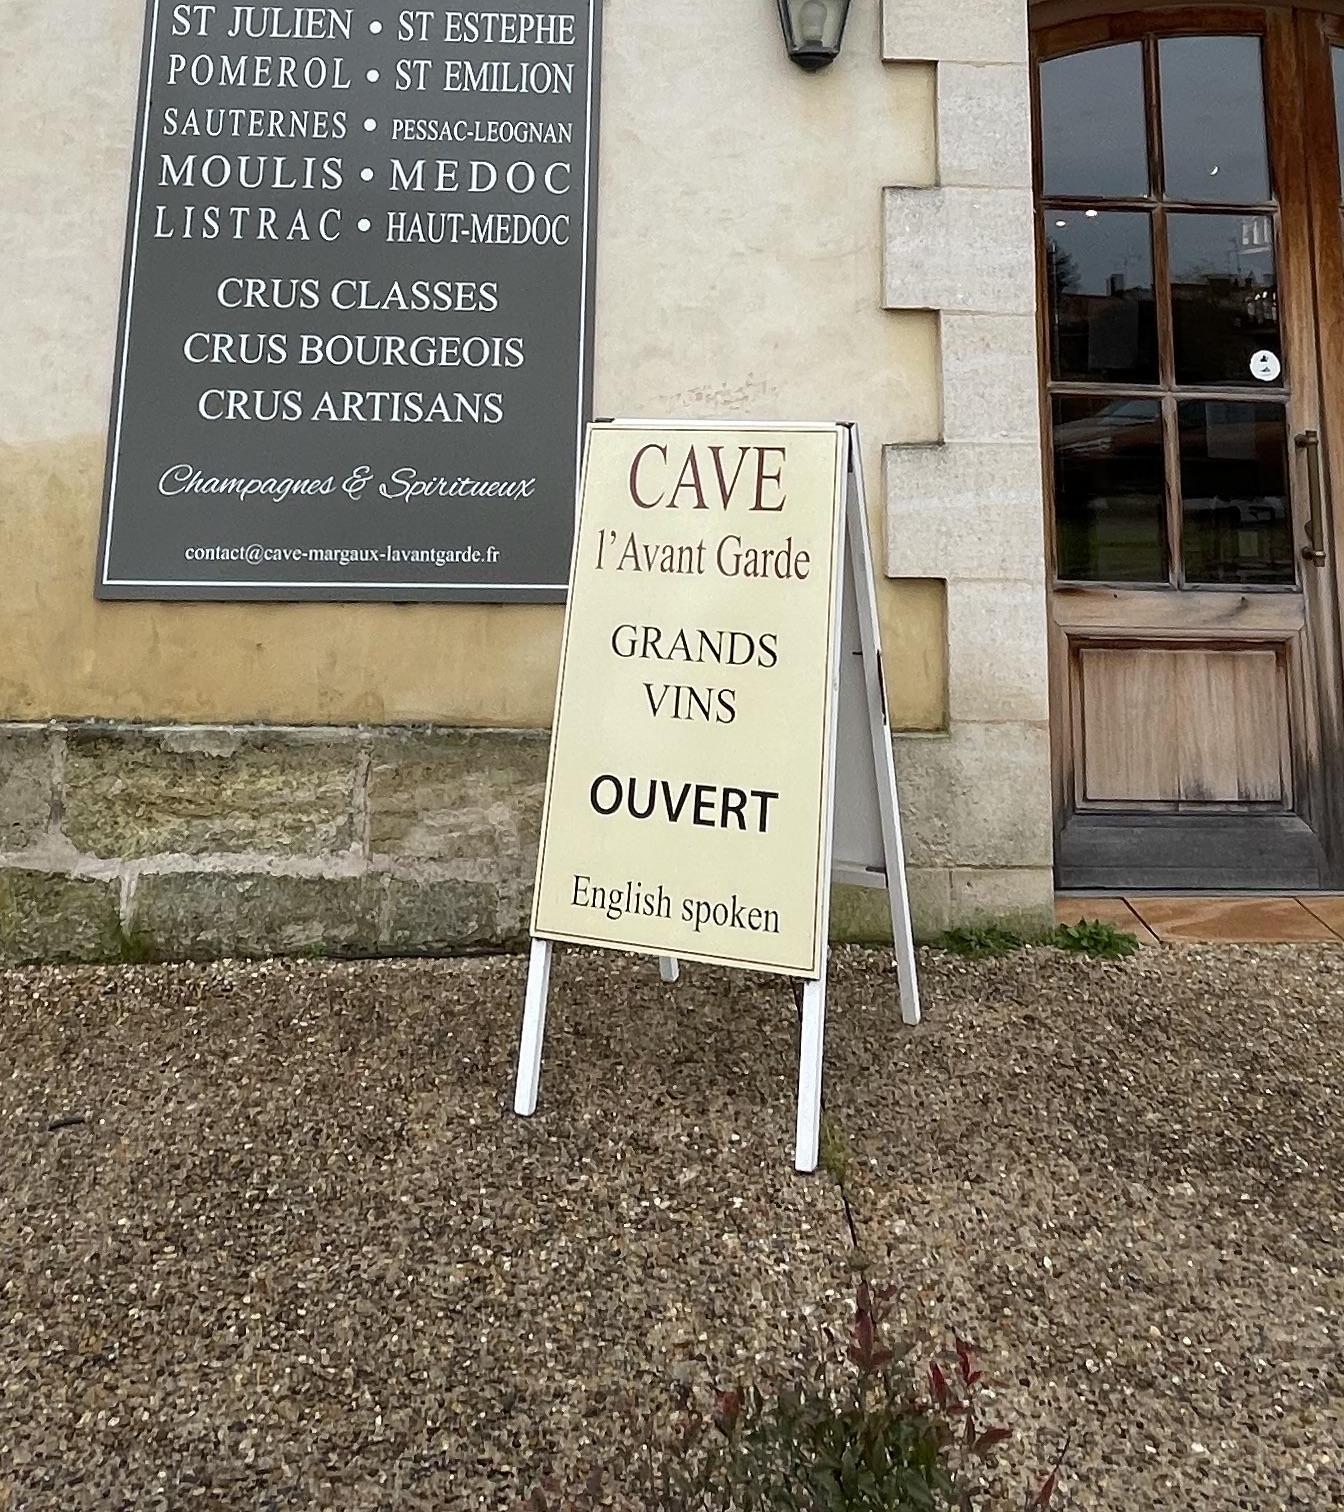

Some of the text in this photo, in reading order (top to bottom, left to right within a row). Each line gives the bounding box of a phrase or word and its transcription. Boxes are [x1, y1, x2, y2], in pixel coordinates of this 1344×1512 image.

[172, 5, 575, 44] ST JULIEN ST ESTEPHE
[168, 55, 574, 93] POMEROL ST EMILION
[164, 108, 572, 143] SAUTERNES PESSAC-LEOGNAN
[159, 155, 570, 194] MOULIS MEDOC
[155, 206, 569, 244] LISTRAC HAUT-MEDOC
[218, 278, 497, 311] CRUS CLASSES
[184, 333, 523, 367] CRUS BOURGEOIS
[199, 390, 502, 423] CRUS ARTISANS
[159, 464, 535, 502] Champagnes & Spiritueux
[630, 444, 786, 511] CAVE
[186, 544, 499, 566] contact@cave-margaux-lavantgarde.fr
[596, 530, 809, 579] l'Avant Garde
[612, 625, 777, 667] GRANDS
[643, 683, 735, 723] VINS
[591, 775, 778, 832] OUVERT
[572, 875, 779, 933] English spoken
